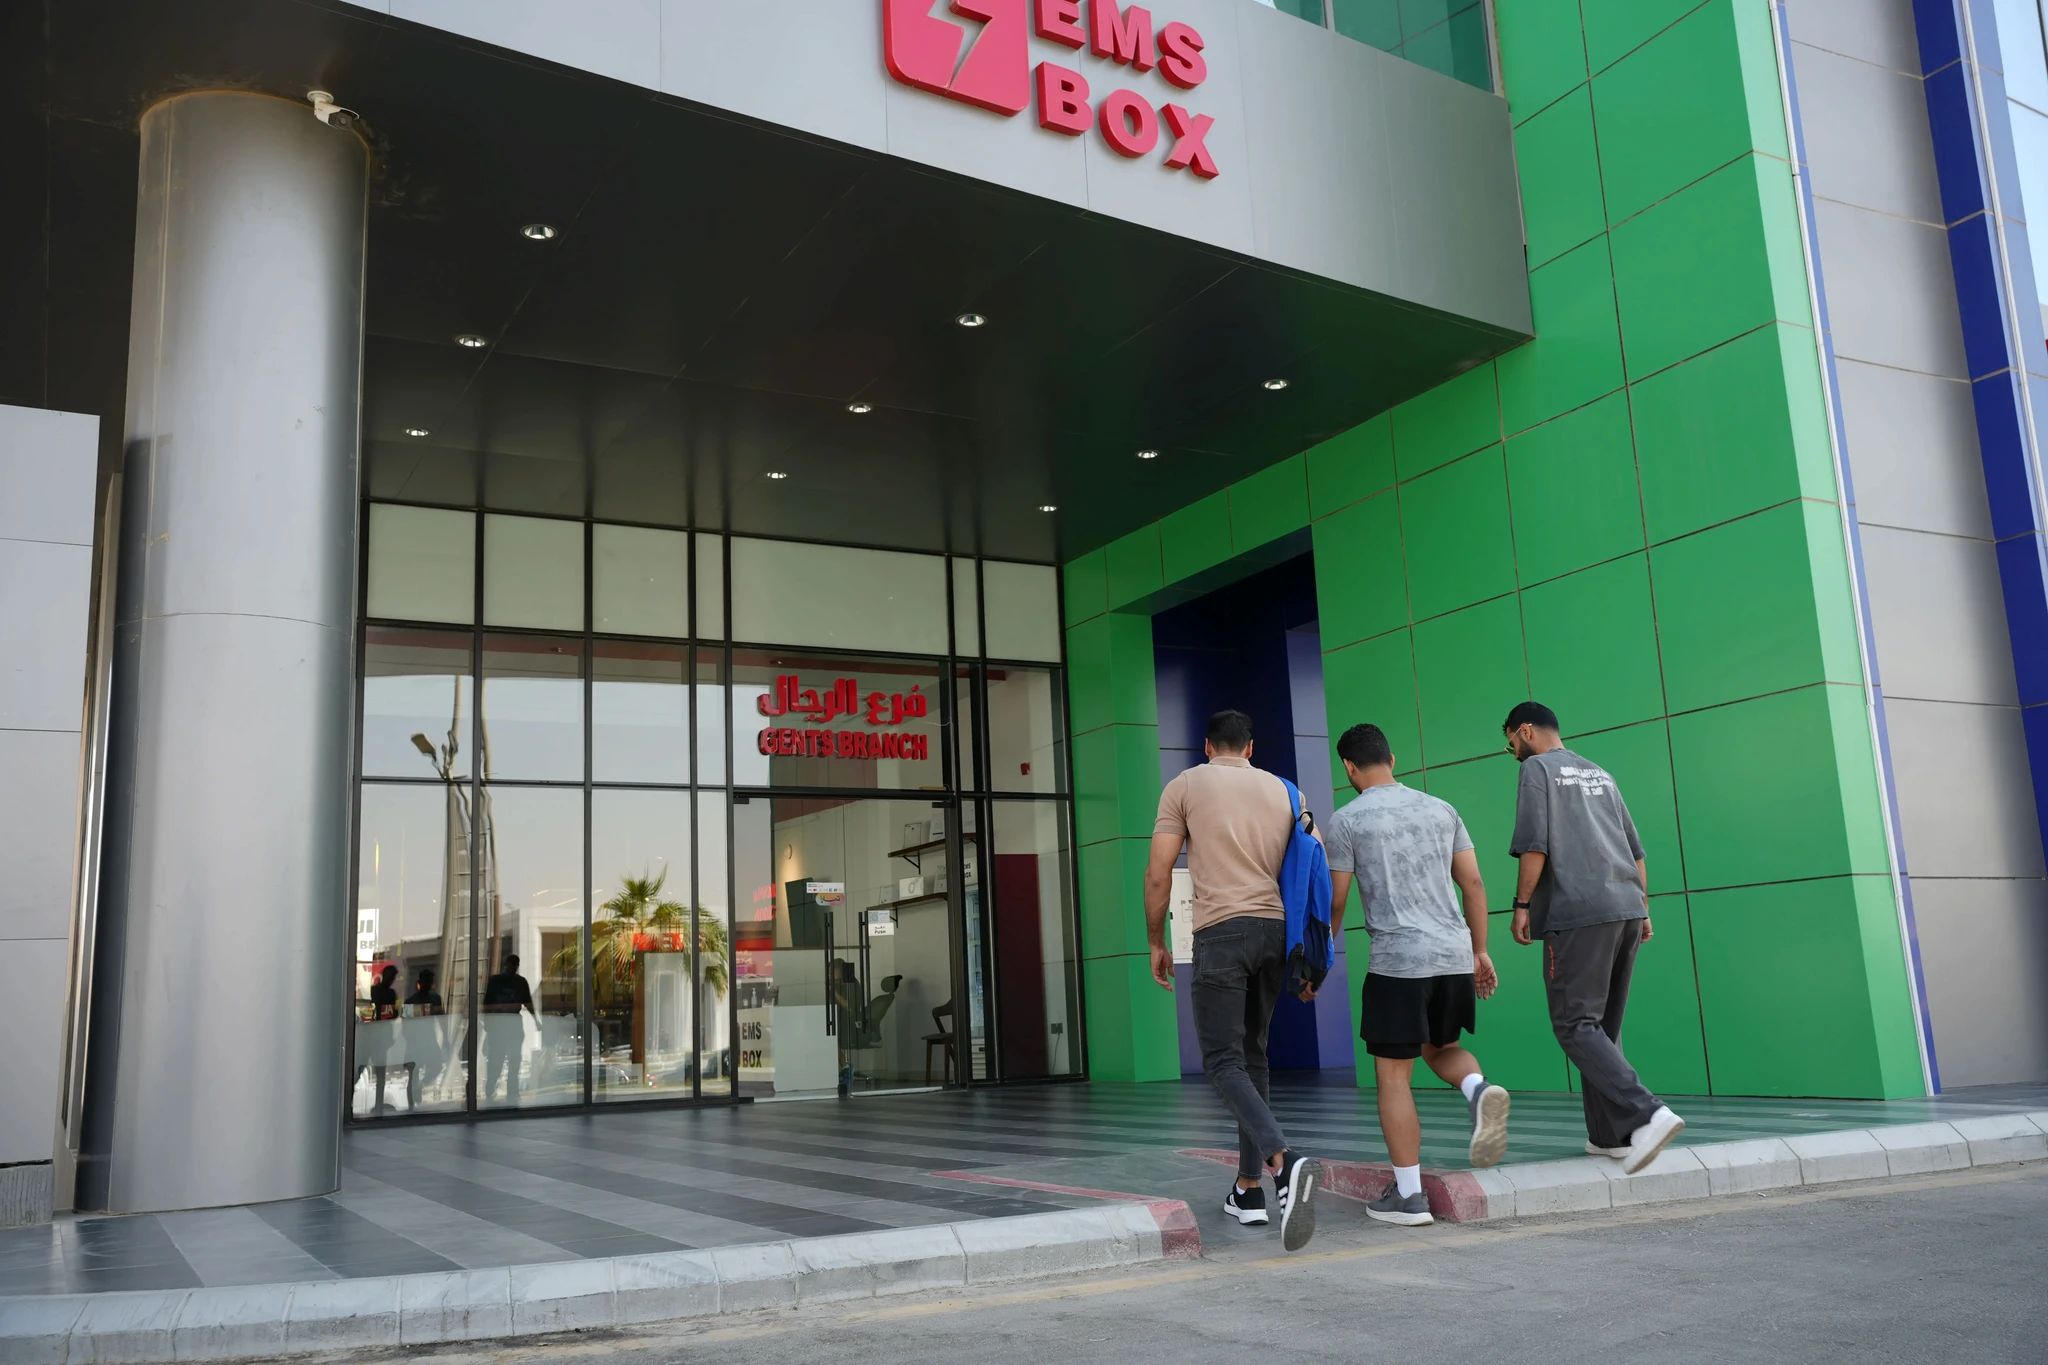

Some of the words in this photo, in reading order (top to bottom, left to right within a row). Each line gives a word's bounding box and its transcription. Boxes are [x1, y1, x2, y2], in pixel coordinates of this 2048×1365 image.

[1034, 0, 1207, 90] EMS
[1035, 61, 1220, 181] BOX
[757, 674, 858, 724] الرجال
[865, 684, 928, 726] فرع
[758, 726, 835, 758] GENTS
[838, 730, 928, 761] BRANCH
[741, 1021, 762, 1040] EMS
[742, 1050, 763, 1068] BOX
